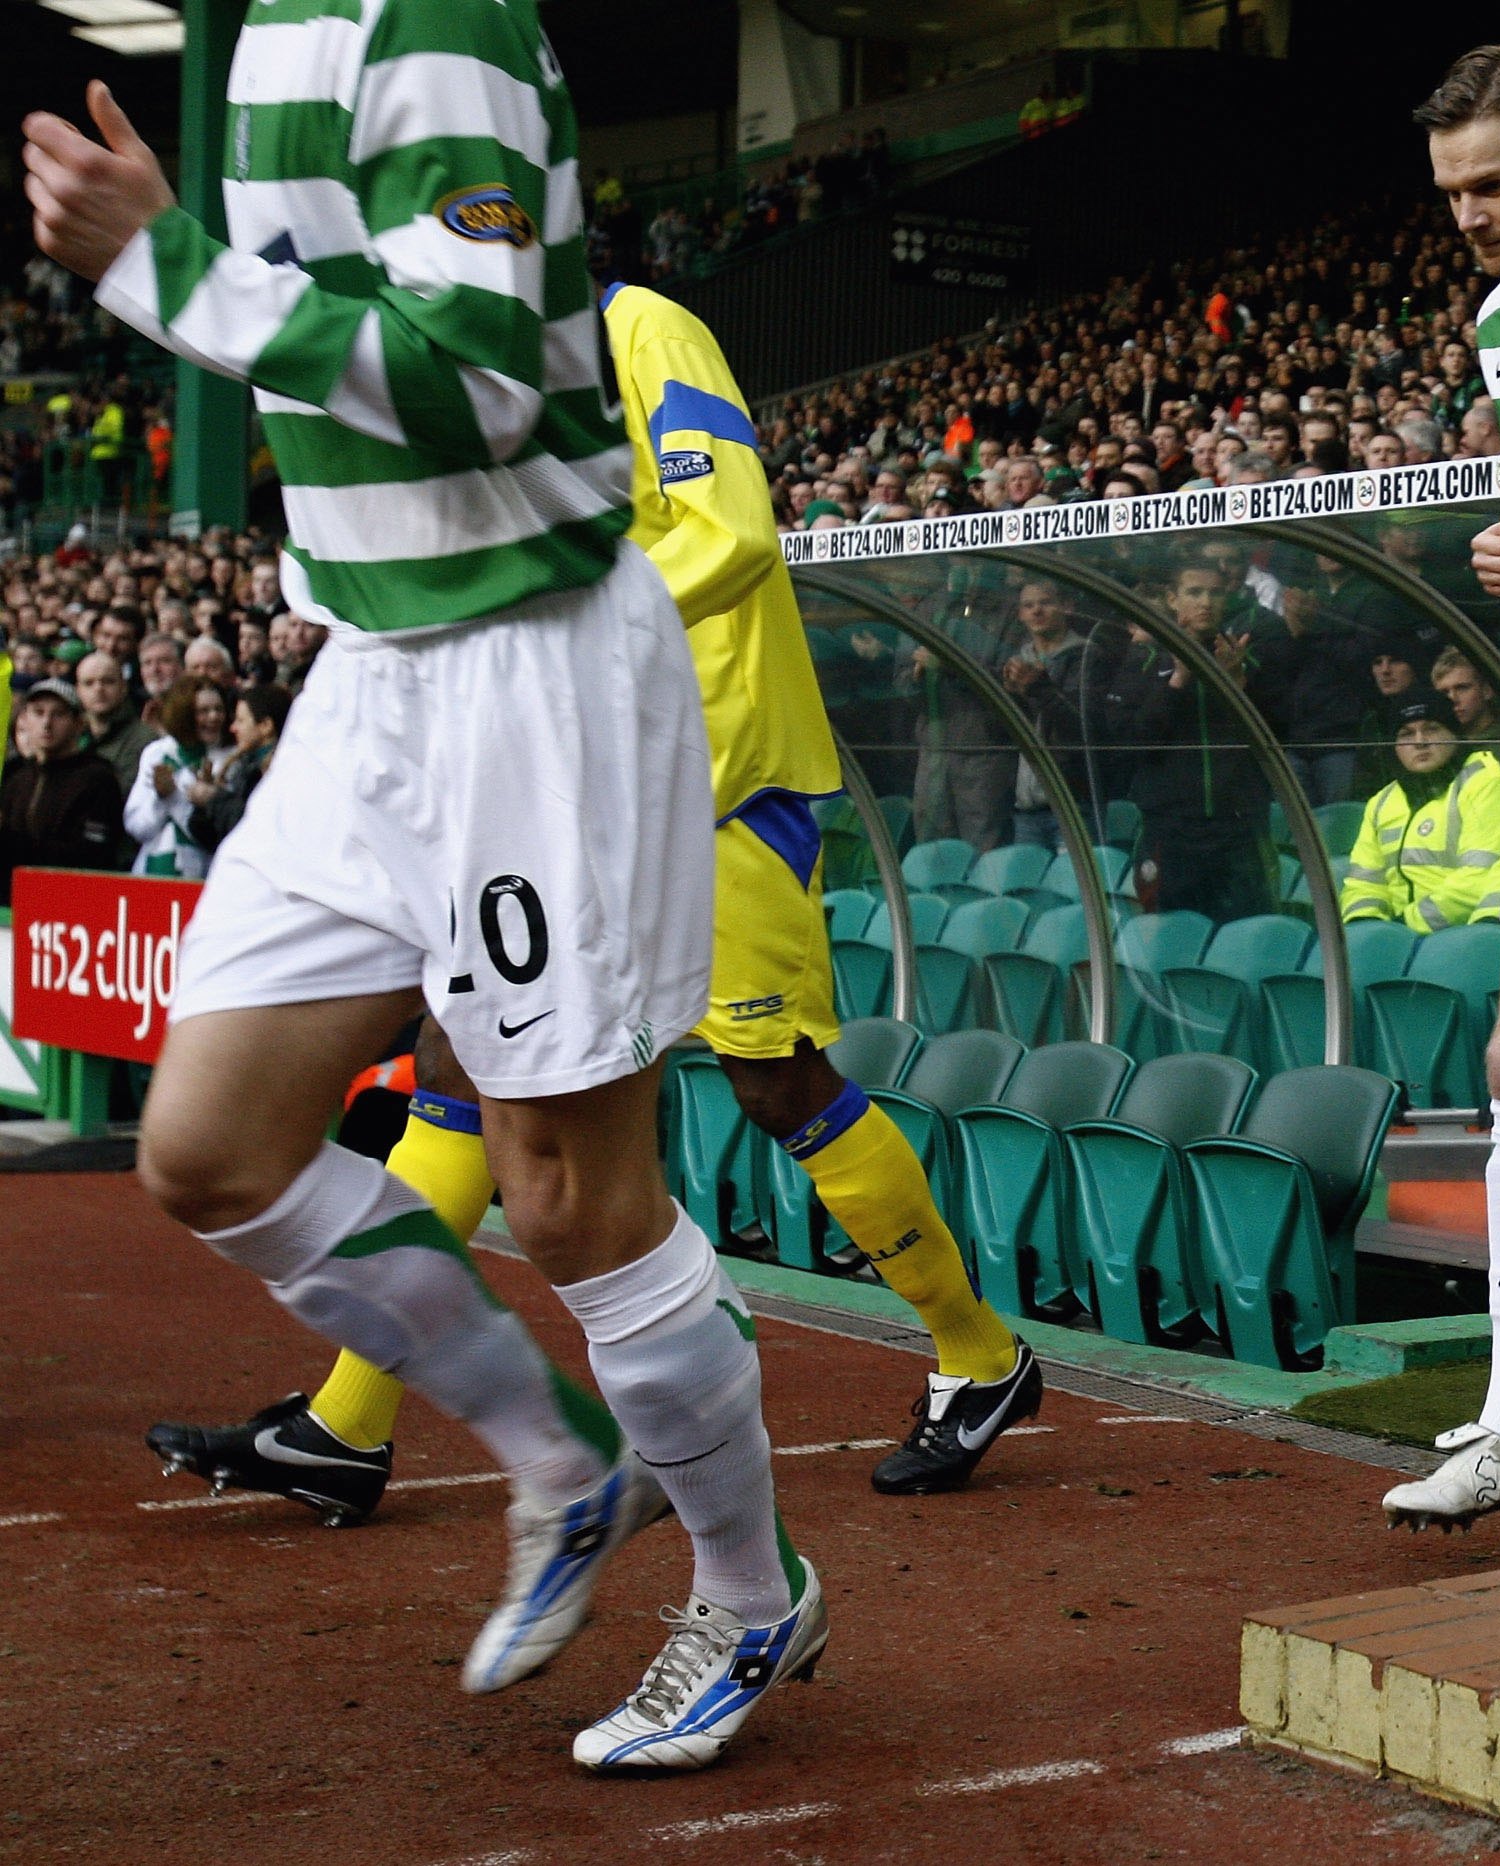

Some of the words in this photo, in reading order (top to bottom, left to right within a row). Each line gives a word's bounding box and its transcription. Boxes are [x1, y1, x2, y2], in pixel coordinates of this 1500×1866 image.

[831, 525, 904, 559] BET24.COM
[923, 517, 1002, 550] BET24.COM
[1022, 504, 1110, 541] BET24.COM
[1131, 491, 1226, 530] BET24.COM
[1250, 478, 1354, 521] BET24.COM
[1379, 462, 1493, 506] BET24.COM
[28, 920, 90, 997] 1152
[95, 895, 181, 1041] clyd
